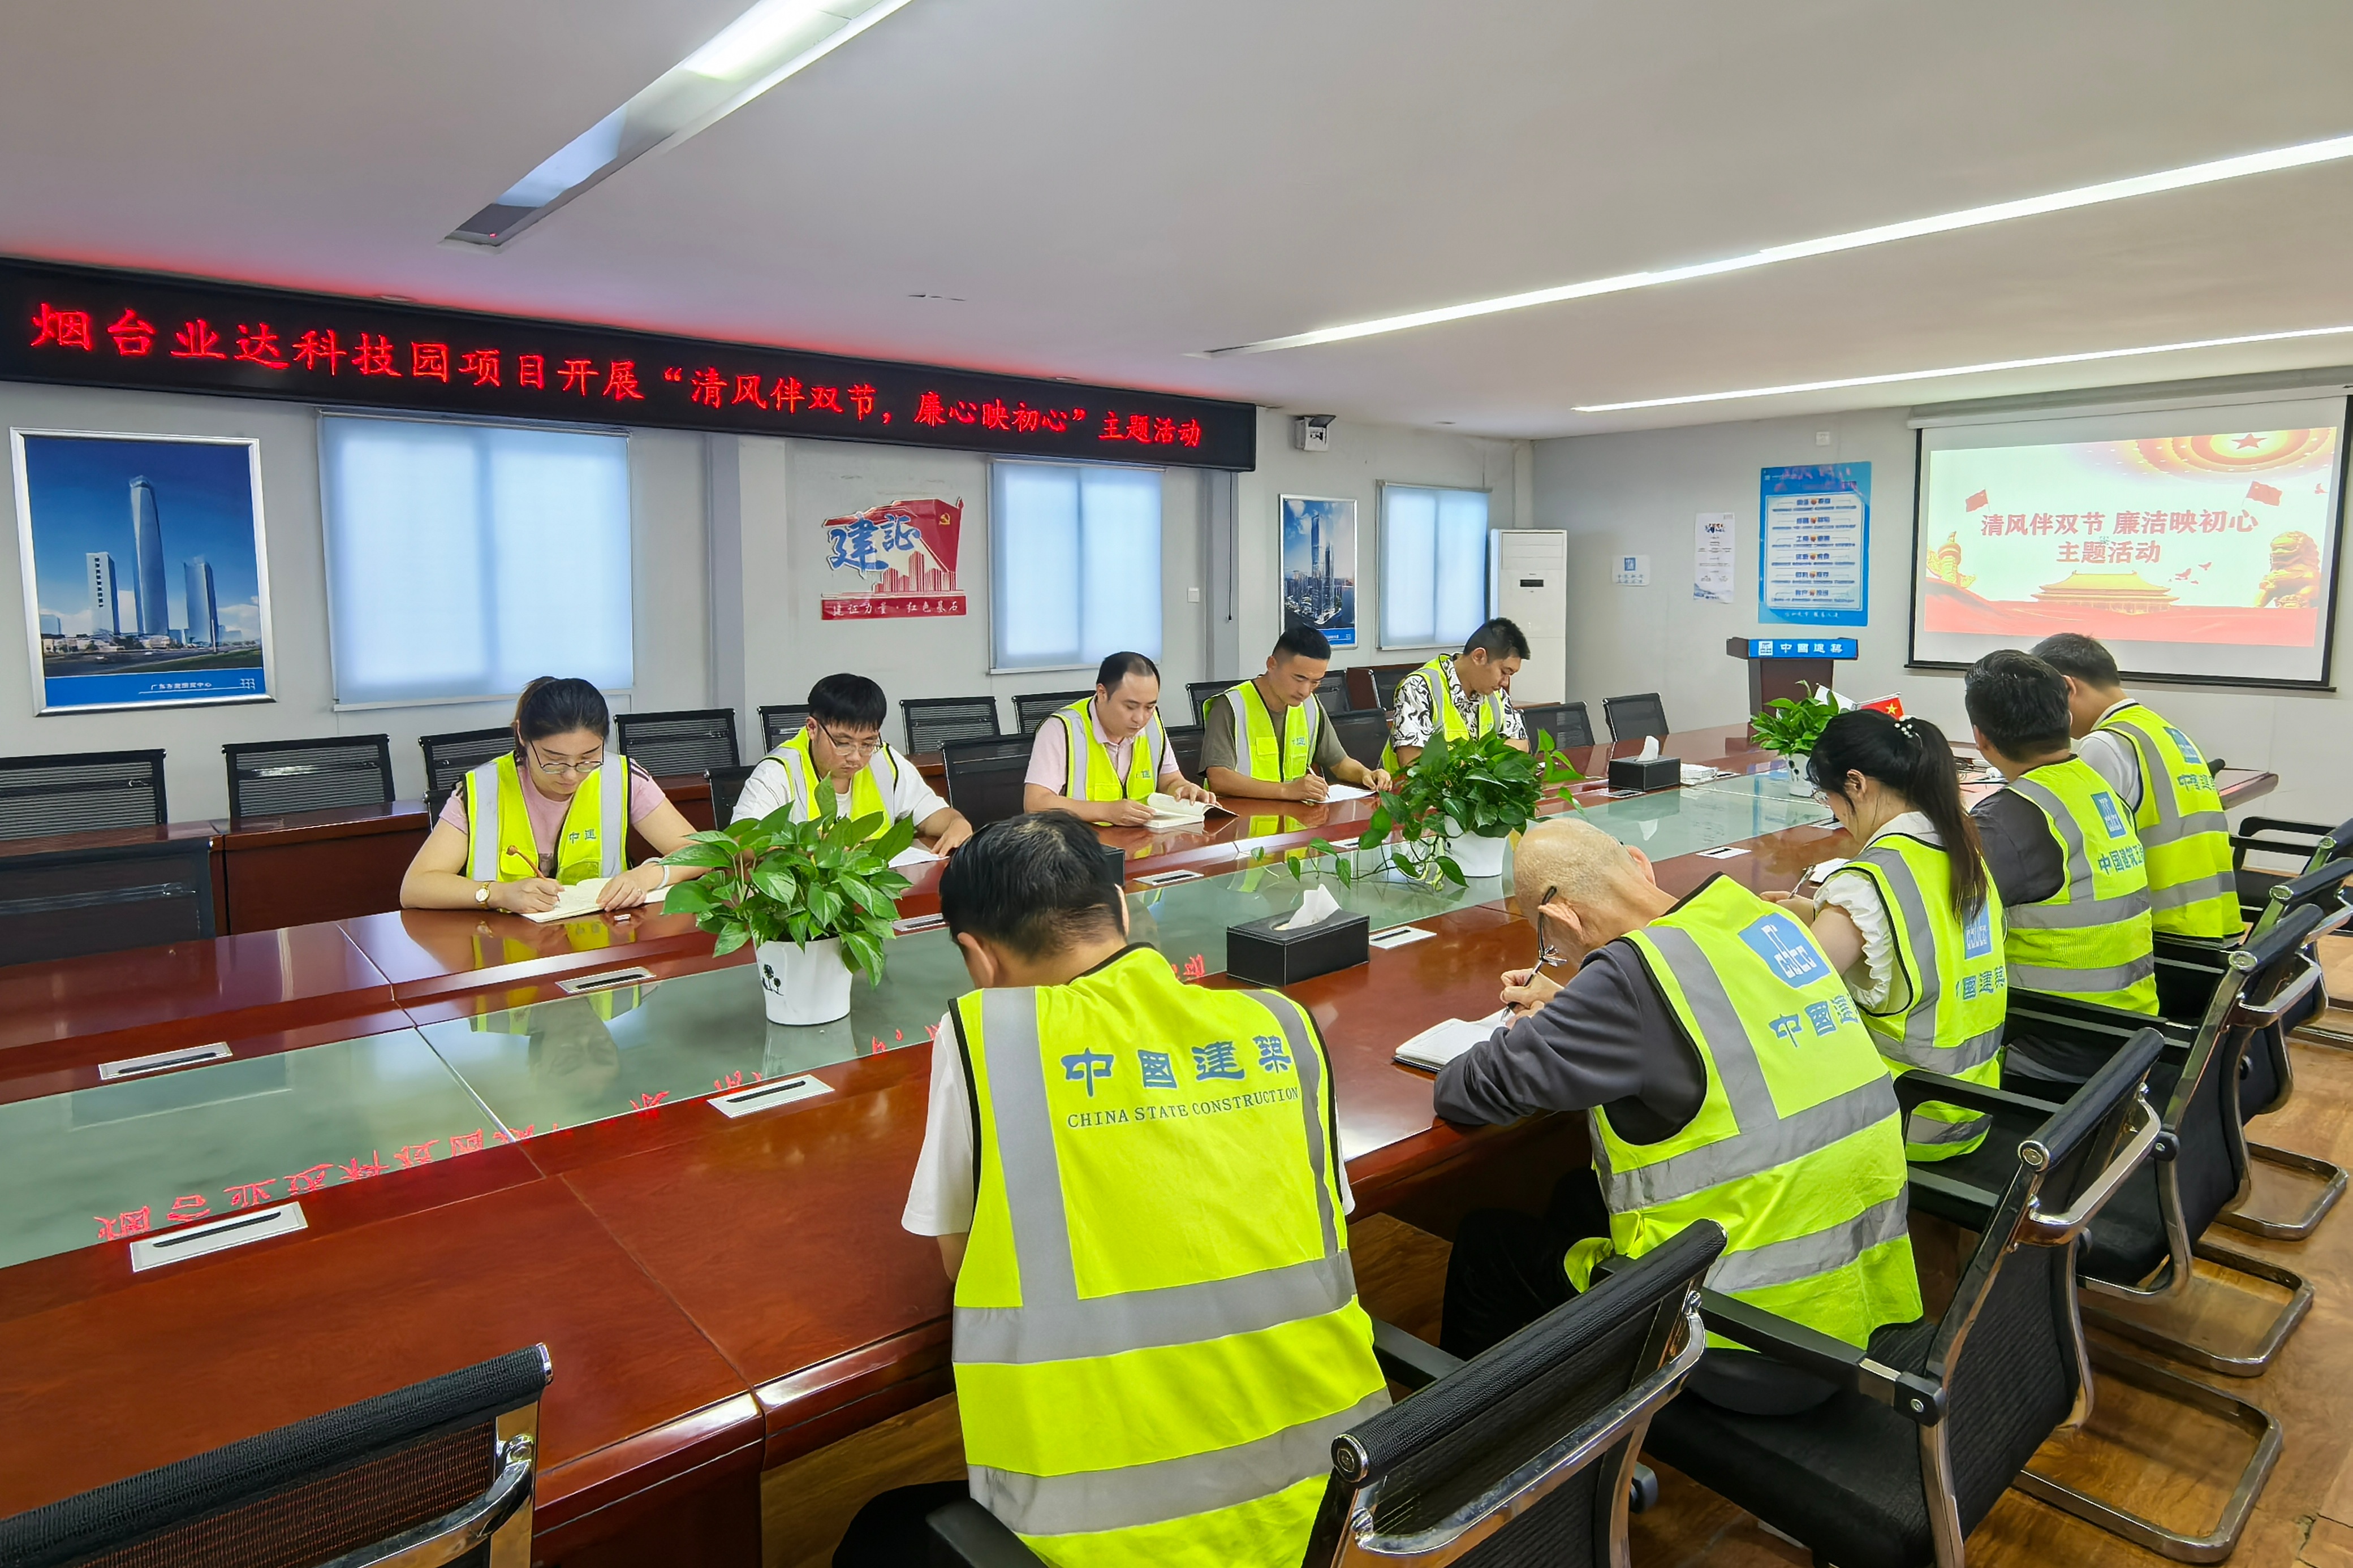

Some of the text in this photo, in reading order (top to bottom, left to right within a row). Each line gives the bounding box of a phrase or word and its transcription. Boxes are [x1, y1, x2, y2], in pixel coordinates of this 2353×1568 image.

[1980, 509, 2259, 536] 清风伴双节 廉洁映初心
[2056, 541, 2161, 564] 主题活动
[1067, 1086, 1299, 1129] CHINA STATE CONSTRUCTION
